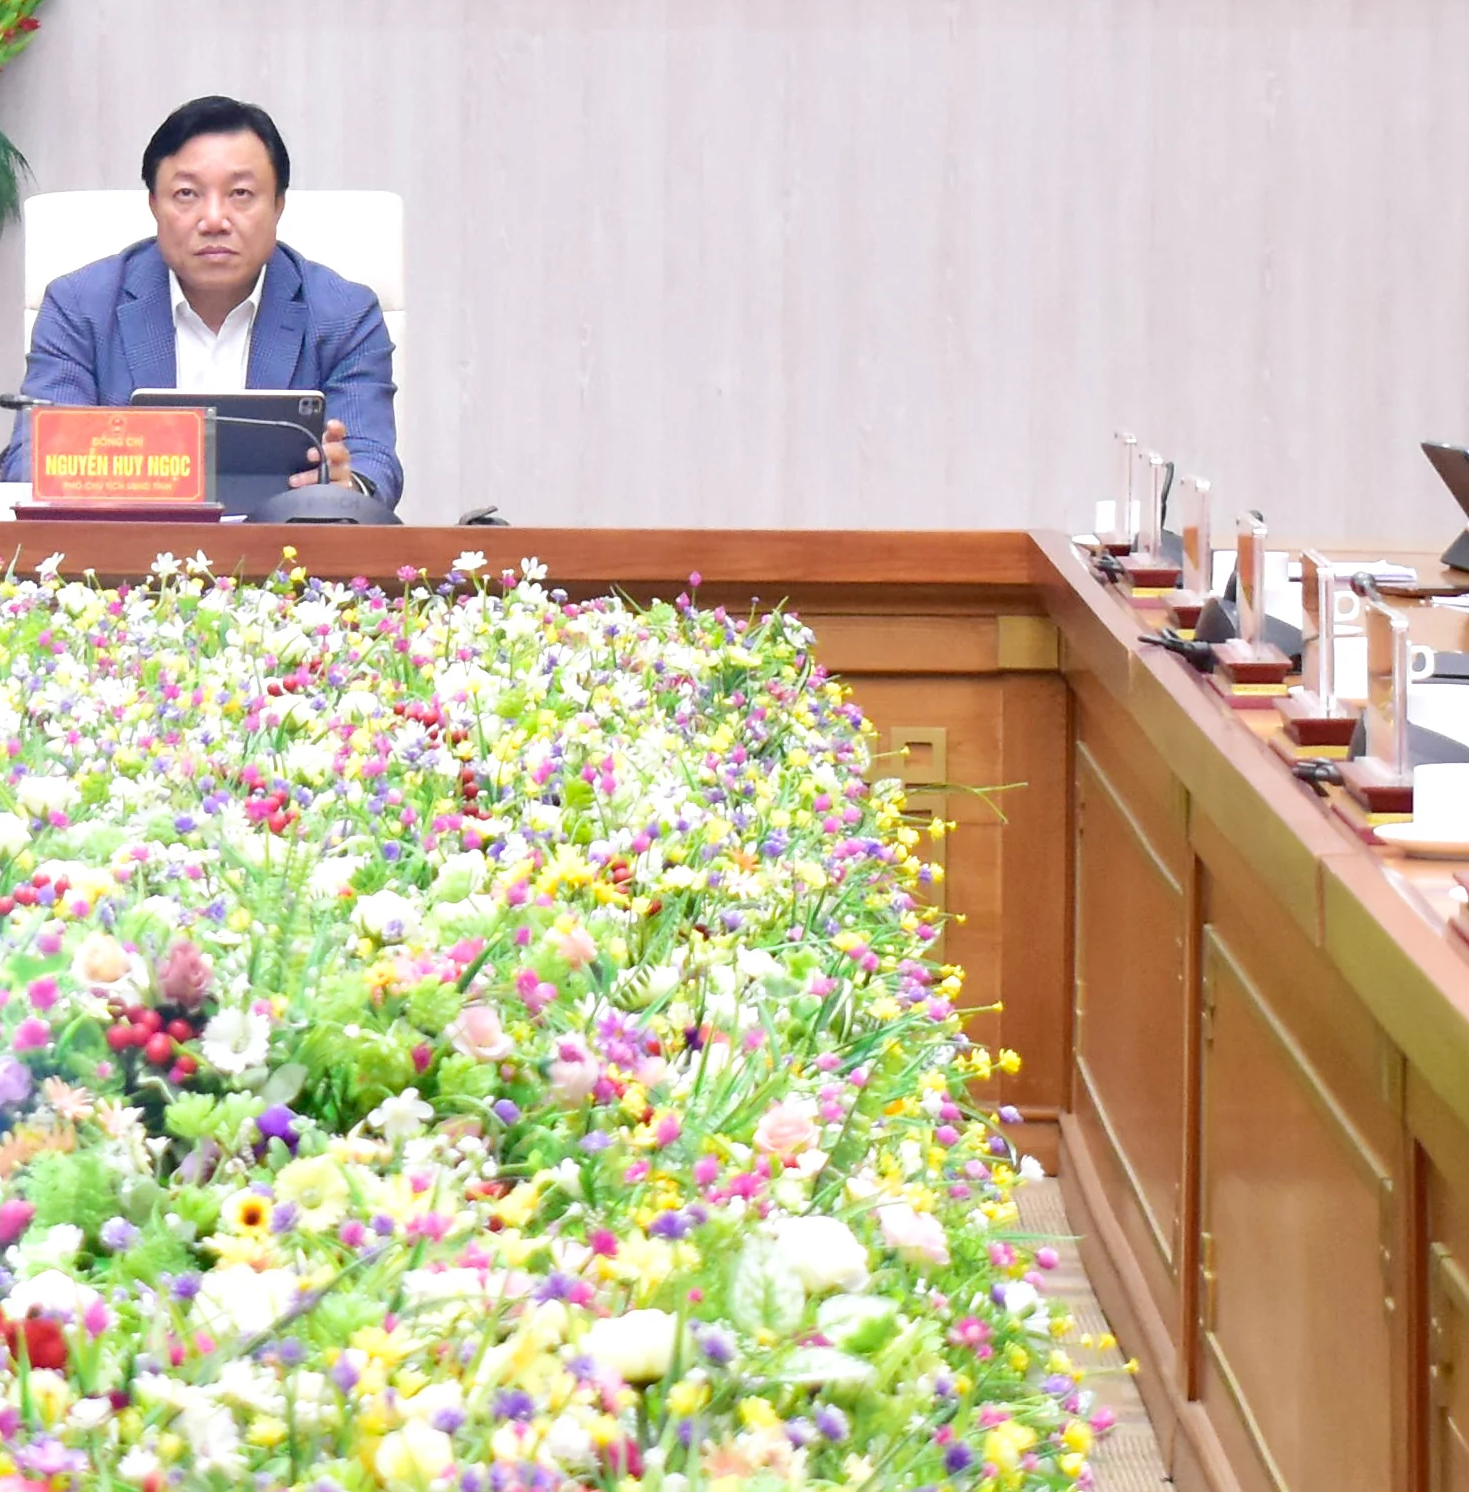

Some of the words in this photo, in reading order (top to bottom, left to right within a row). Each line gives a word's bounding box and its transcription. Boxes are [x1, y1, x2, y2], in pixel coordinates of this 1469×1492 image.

[45, 447, 109, 477] NGUYỄN
[112, 454, 144, 477] HUY
[147, 454, 191, 482] NGỌC
